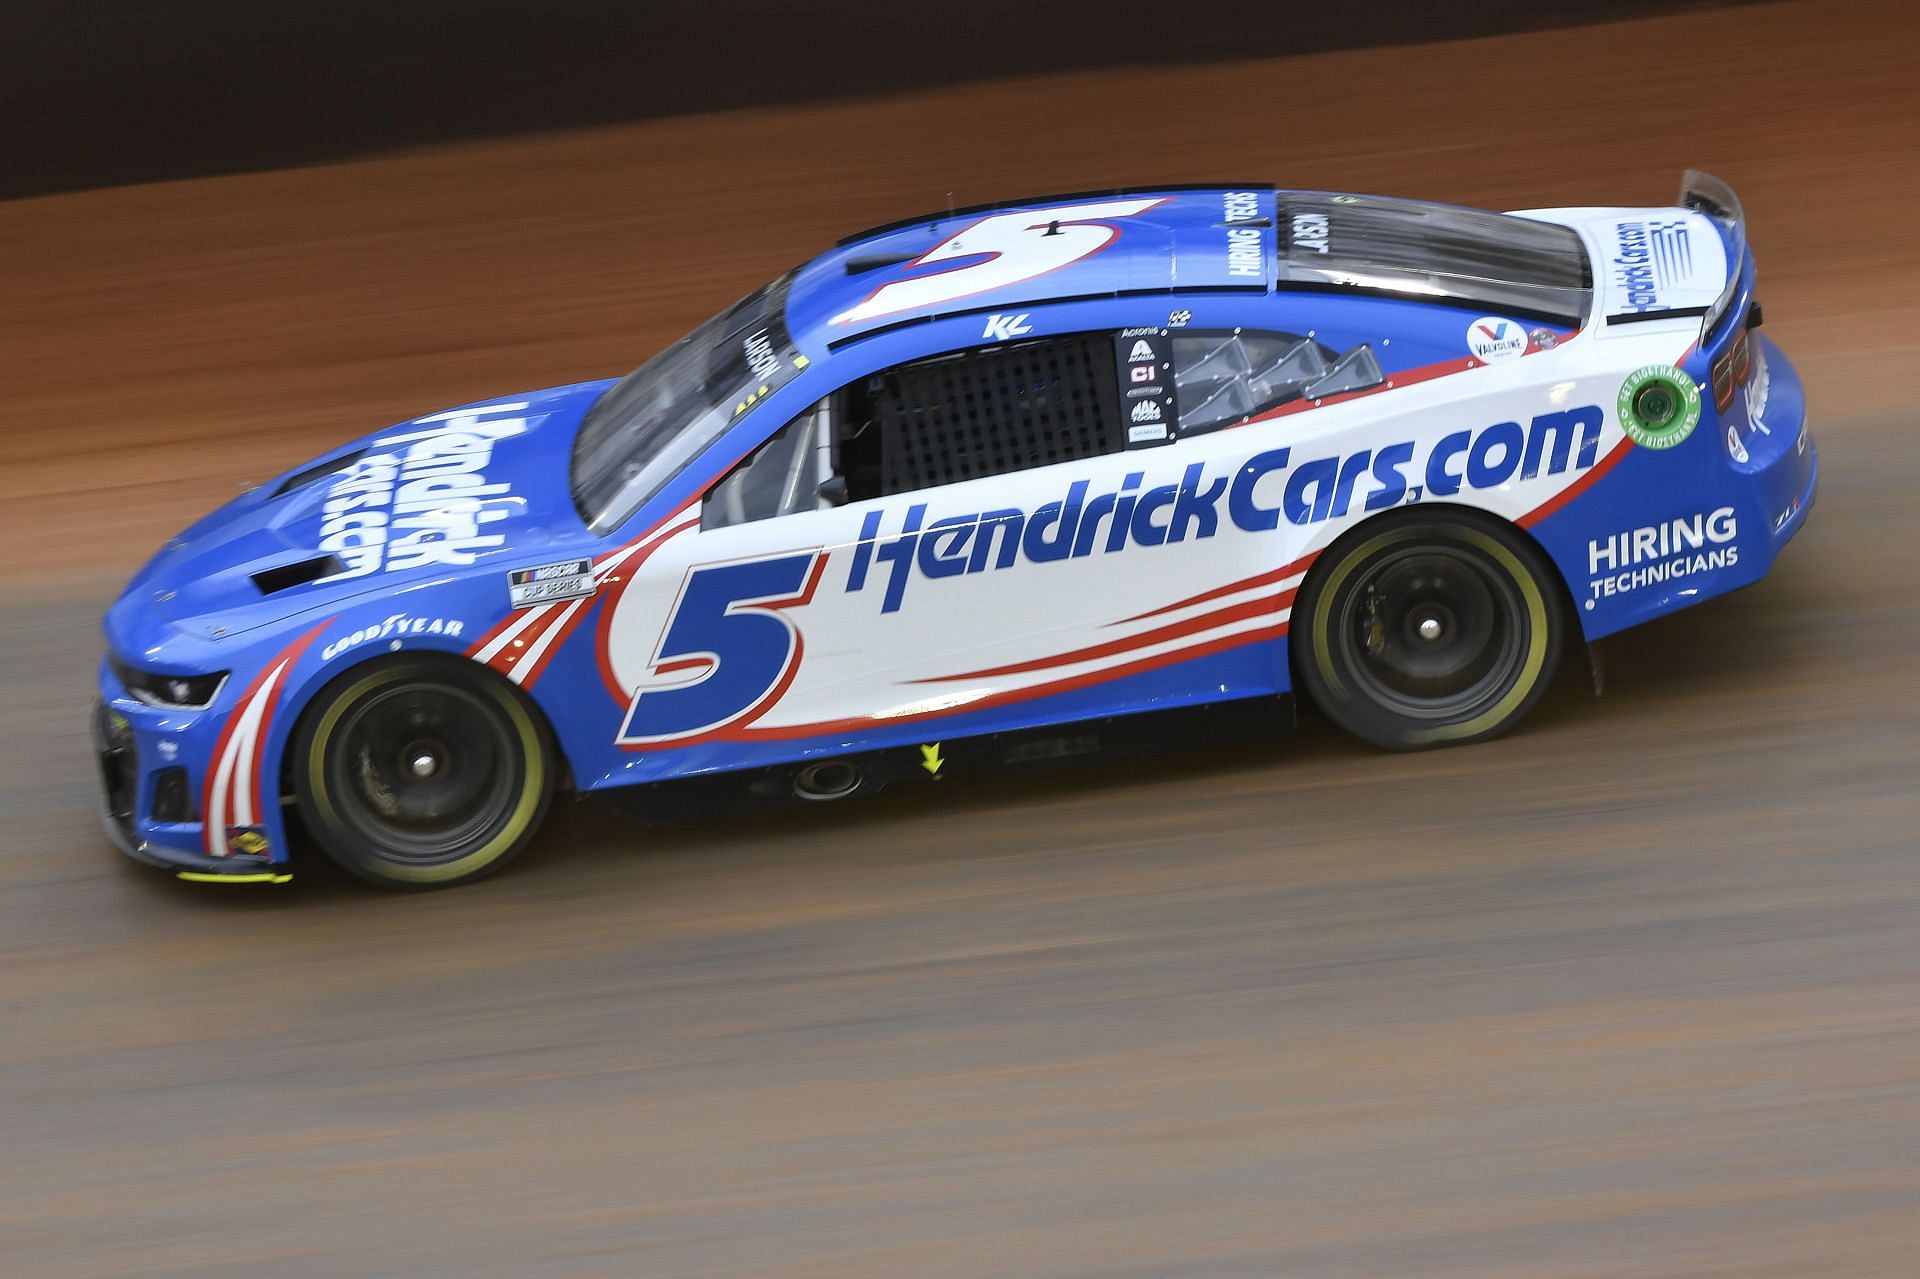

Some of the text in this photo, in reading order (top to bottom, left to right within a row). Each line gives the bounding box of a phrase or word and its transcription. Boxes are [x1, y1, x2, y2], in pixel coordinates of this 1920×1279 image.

[827, 197, 1180, 326] 5
[1227, 229, 1262, 277] HIRING
[743, 326, 781, 381] LARSON
[371, 401, 529, 573] Hendrick
[845, 403, 1604, 613] HendrickCars.com
[1589, 506, 1737, 575] HIRING
[1590, 546, 1739, 600] TECHNICIANS
[321, 612, 465, 661] GOODYEAR
[614, 545, 831, 751] 5
